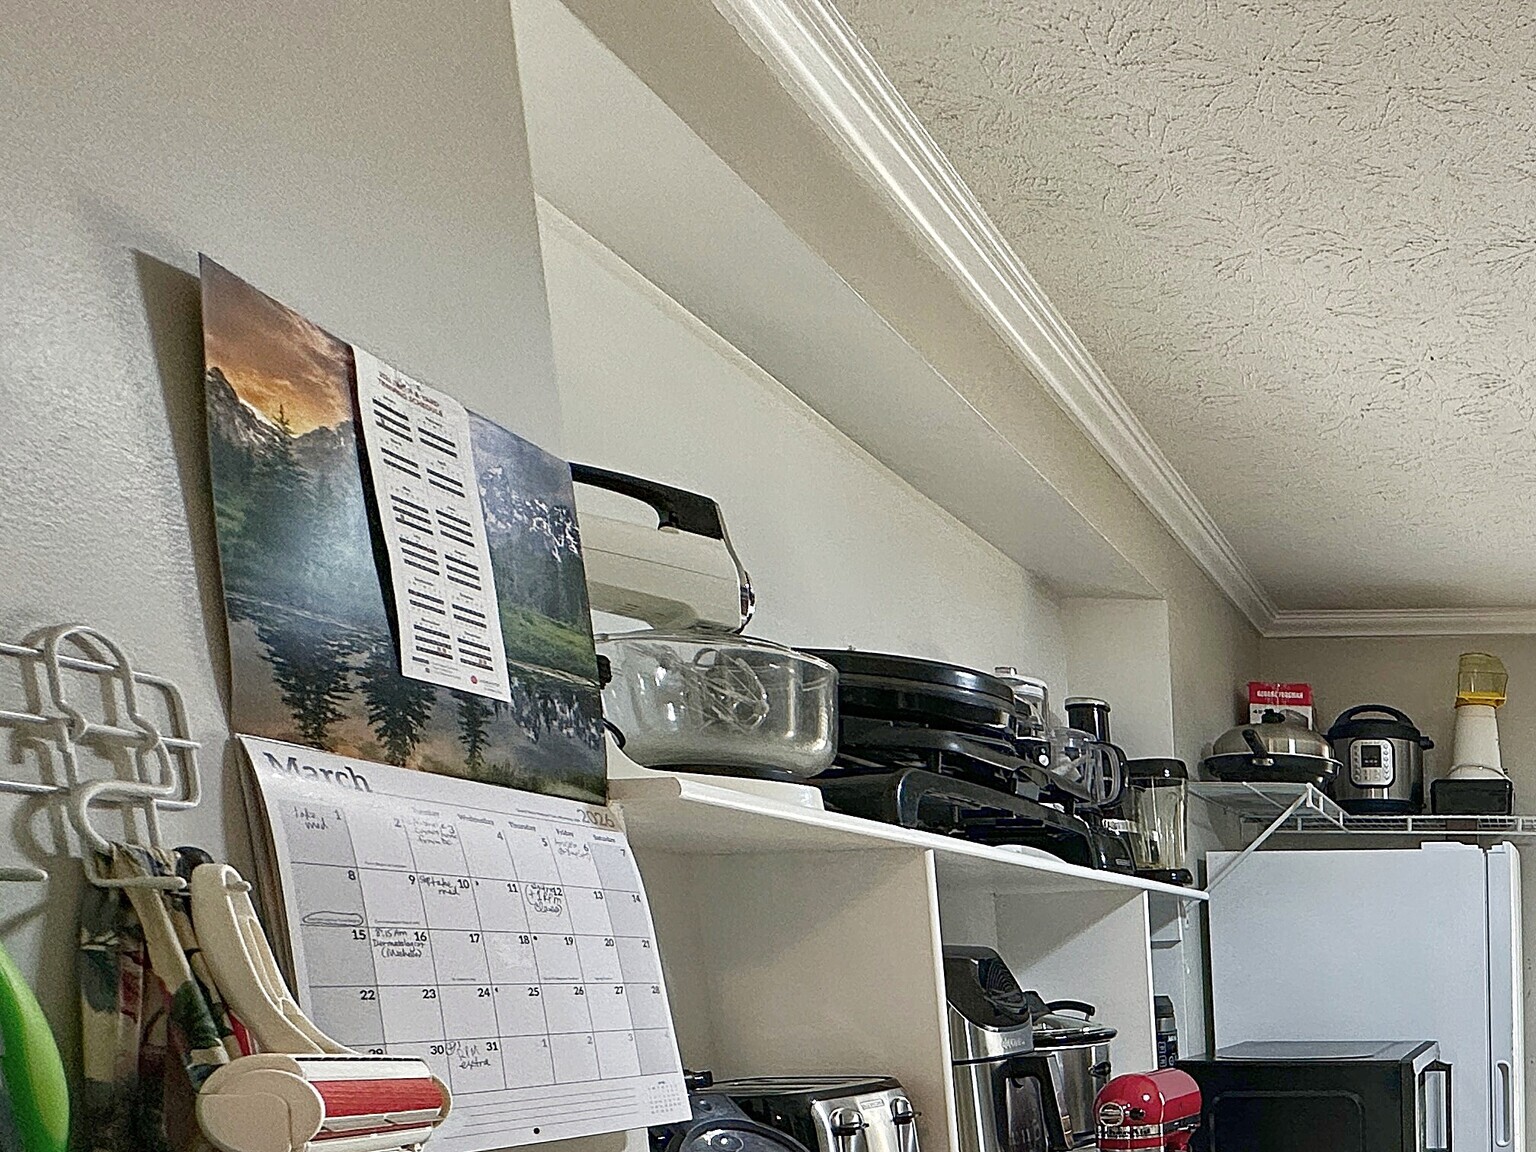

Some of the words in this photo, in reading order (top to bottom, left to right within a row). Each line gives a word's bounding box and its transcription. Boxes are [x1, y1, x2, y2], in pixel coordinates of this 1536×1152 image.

[263, 752, 374, 793] March
[576, 808, 616, 829] 2026
[347, 869, 356, 881] 8
[407, 874, 416, 885] 9
[456, 877, 470, 889] 10
[506, 882, 518, 894] 11
[552, 886, 564, 897] 12
[592, 889, 604, 901] 13
[631, 893, 641, 904] 14
[351, 928, 367, 941] 15
[413, 931, 428, 942] 16
[469, 933, 480, 944] 17
[518, 934, 530, 945] 18
[563, 936, 574, 946] 19
[604, 938, 615, 947] 20
[641, 939, 650, 948] 21
[359, 989, 376, 1001] 22
[422, 989, 437, 999] 23
[477, 987, 491, 998] 24
[527, 986, 540, 997] 25
[572, 985, 585, 996] 26
[614, 985, 625, 995] 27
[650, 985, 661, 995] 28
[429, 1045, 445, 1056] 30
[485, 1041, 499, 1051] 31
